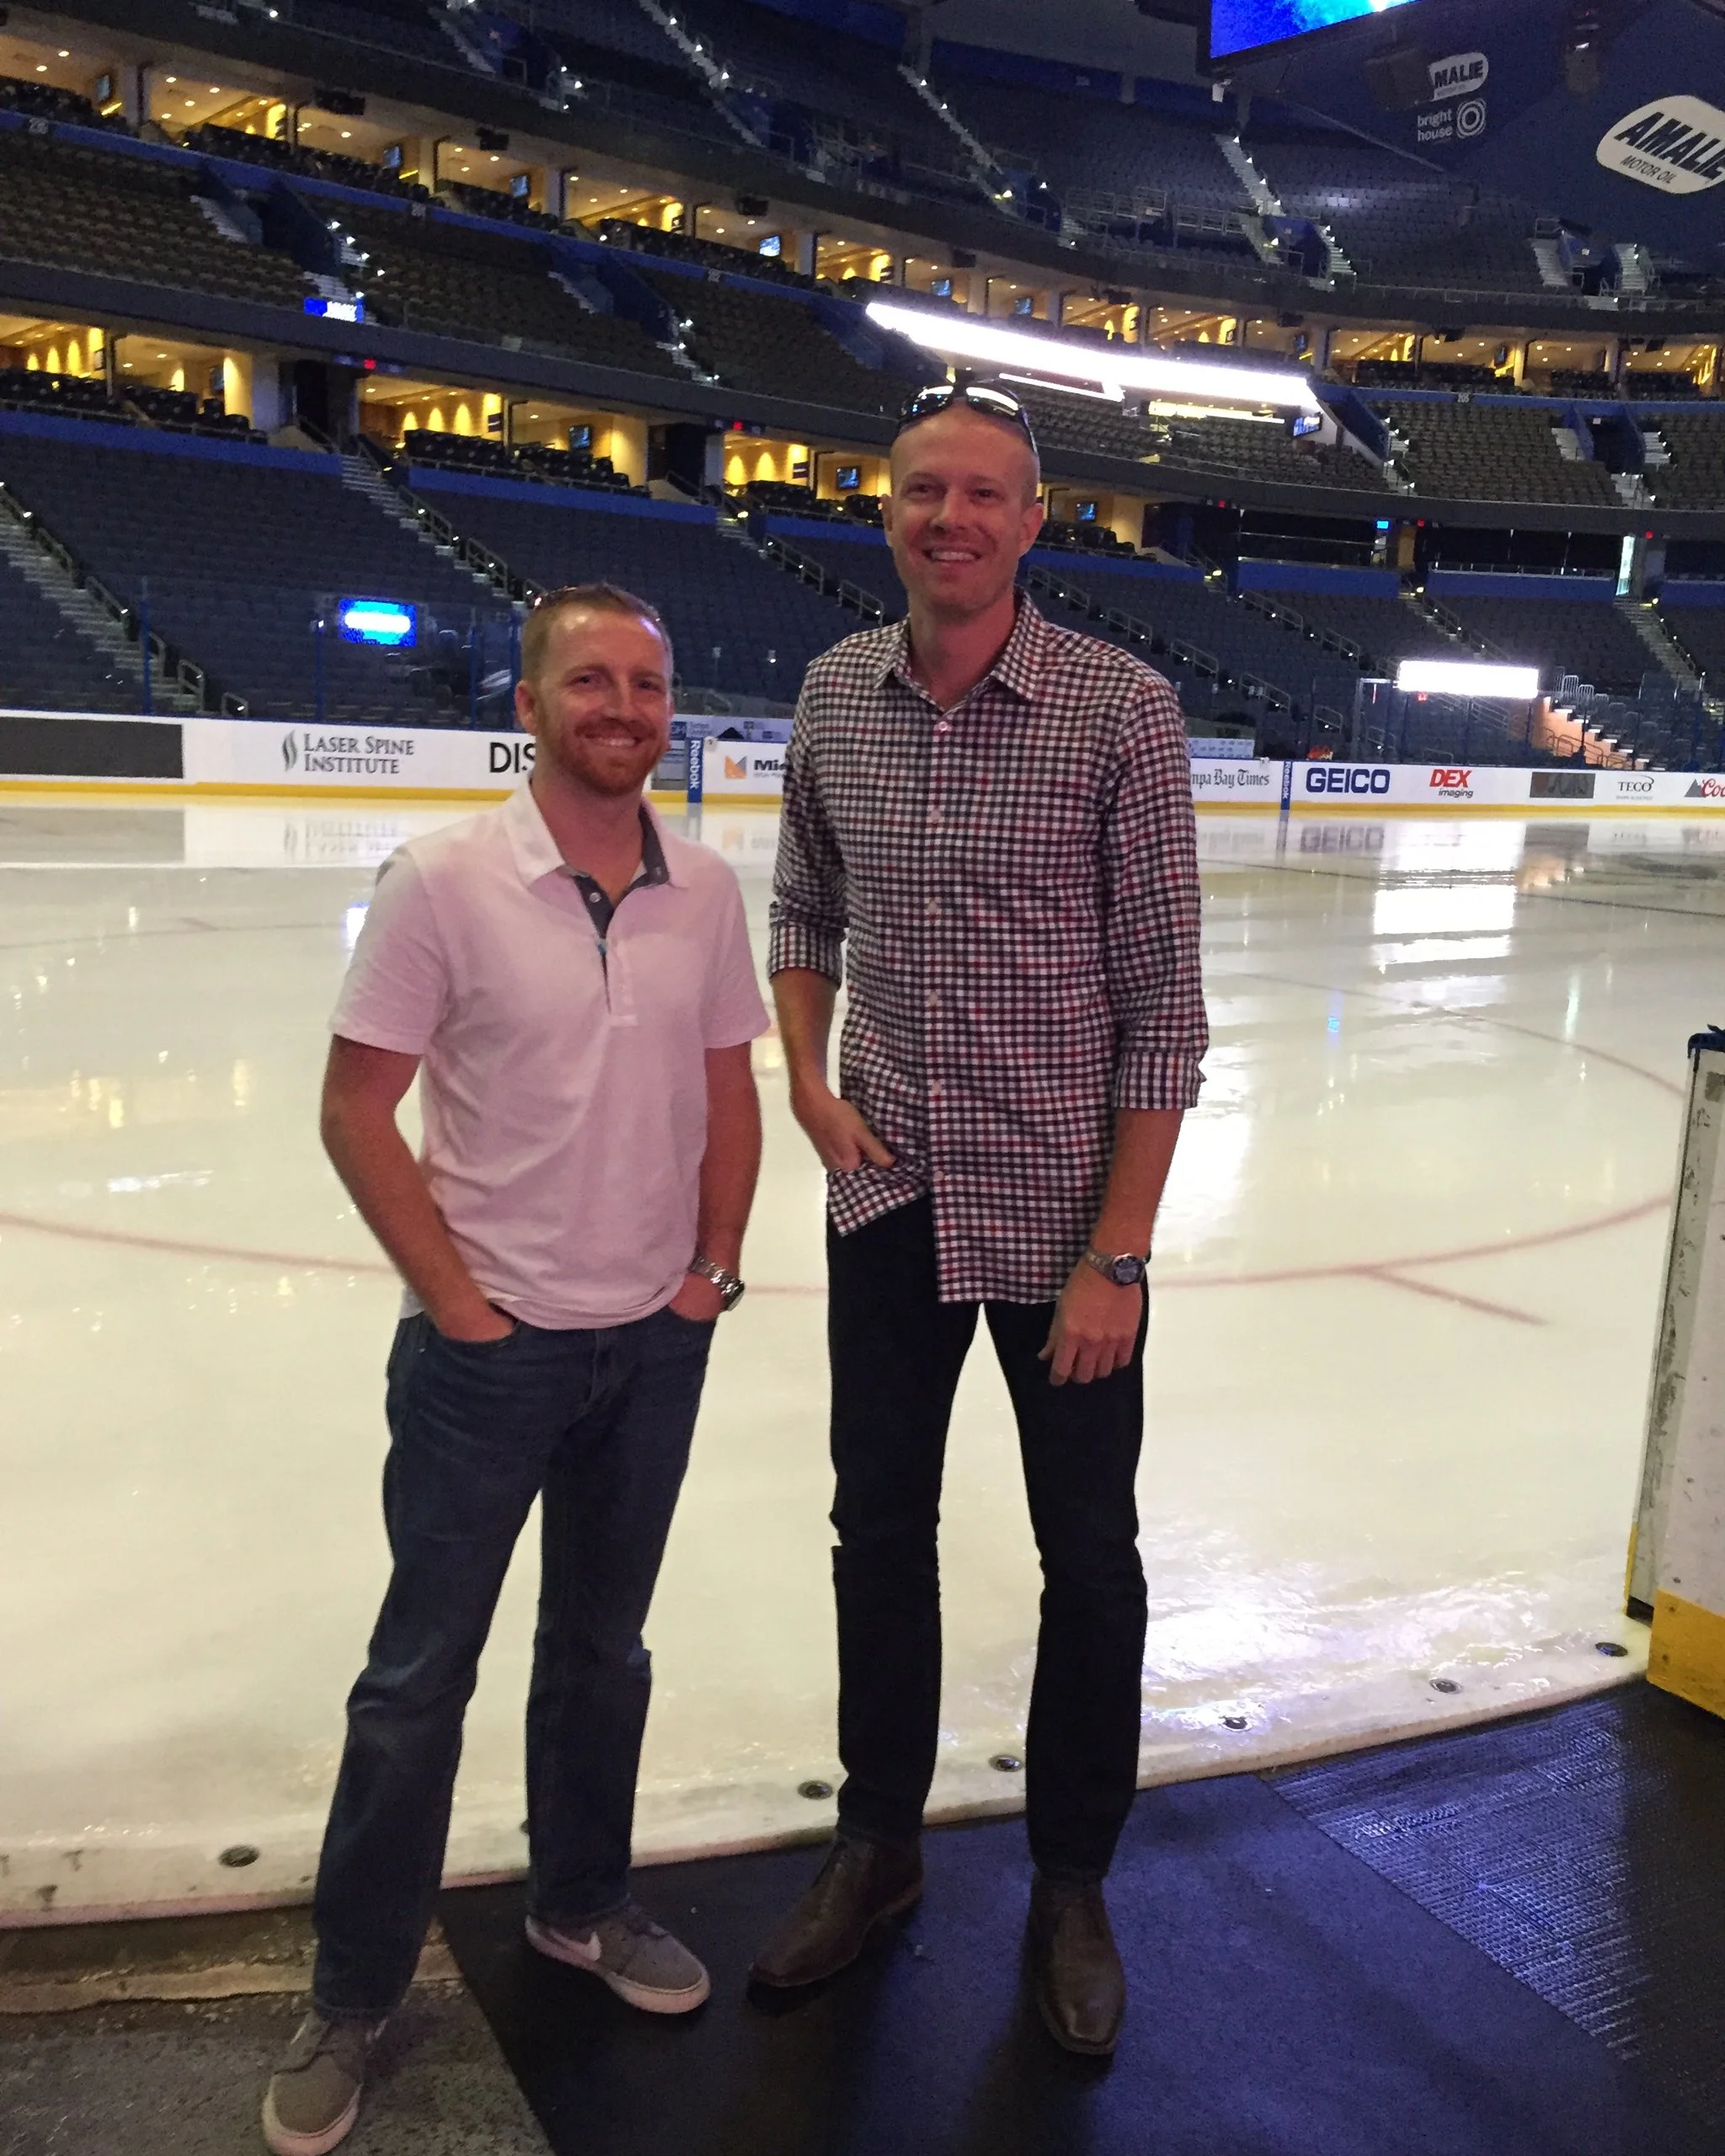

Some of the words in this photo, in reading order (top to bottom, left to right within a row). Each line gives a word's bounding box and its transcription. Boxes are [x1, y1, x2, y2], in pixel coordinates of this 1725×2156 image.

[1434, 60, 1484, 88] MALIE
[1418, 109, 1452, 127] bright
[1418, 126, 1453, 141] house
[1620, 155, 1661, 177] MOTOR
[1657, 171, 1678, 184] OIL
[303, 734, 361, 753] LASER
[366, 735, 414, 755] SPINE
[304, 753, 400, 774] INSTITUTE
[489, 743, 537, 773] DIS
[690, 739, 701, 789] Reebok
[1214, 768, 1235, 788] Bay
[1237, 769, 1270, 786] Times
[1306, 767, 1391, 793] GEICO
[1429, 768, 1472, 788] DEX
[1617, 781, 1653, 792] TECO
[1439, 787, 1473, 798] imaging
